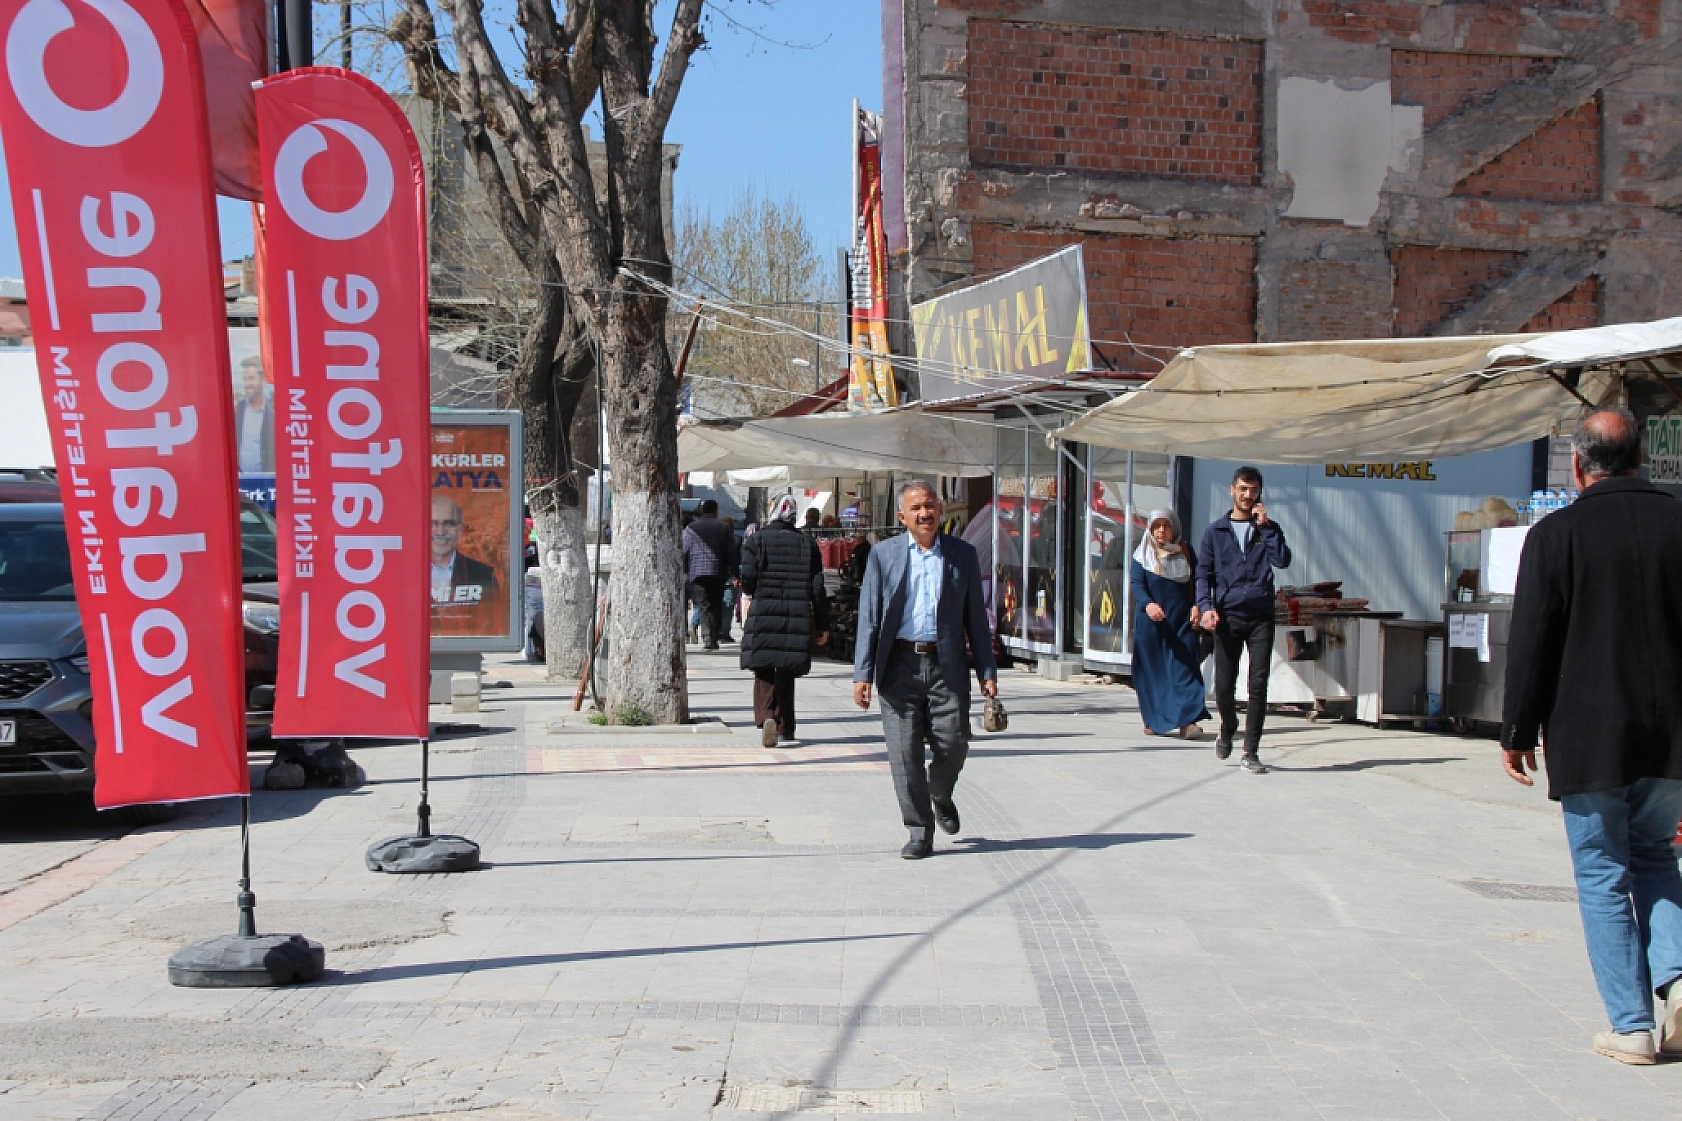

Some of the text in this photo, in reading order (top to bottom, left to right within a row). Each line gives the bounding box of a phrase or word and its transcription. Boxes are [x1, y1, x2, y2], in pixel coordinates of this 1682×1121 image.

[947, 285, 1059, 385] KEMAL
[1647, 415, 1682, 455] TAT
[431, 471, 503, 488] ATYA
[239, 488, 265, 501] rk
[0, 723, 12, 741] 7
